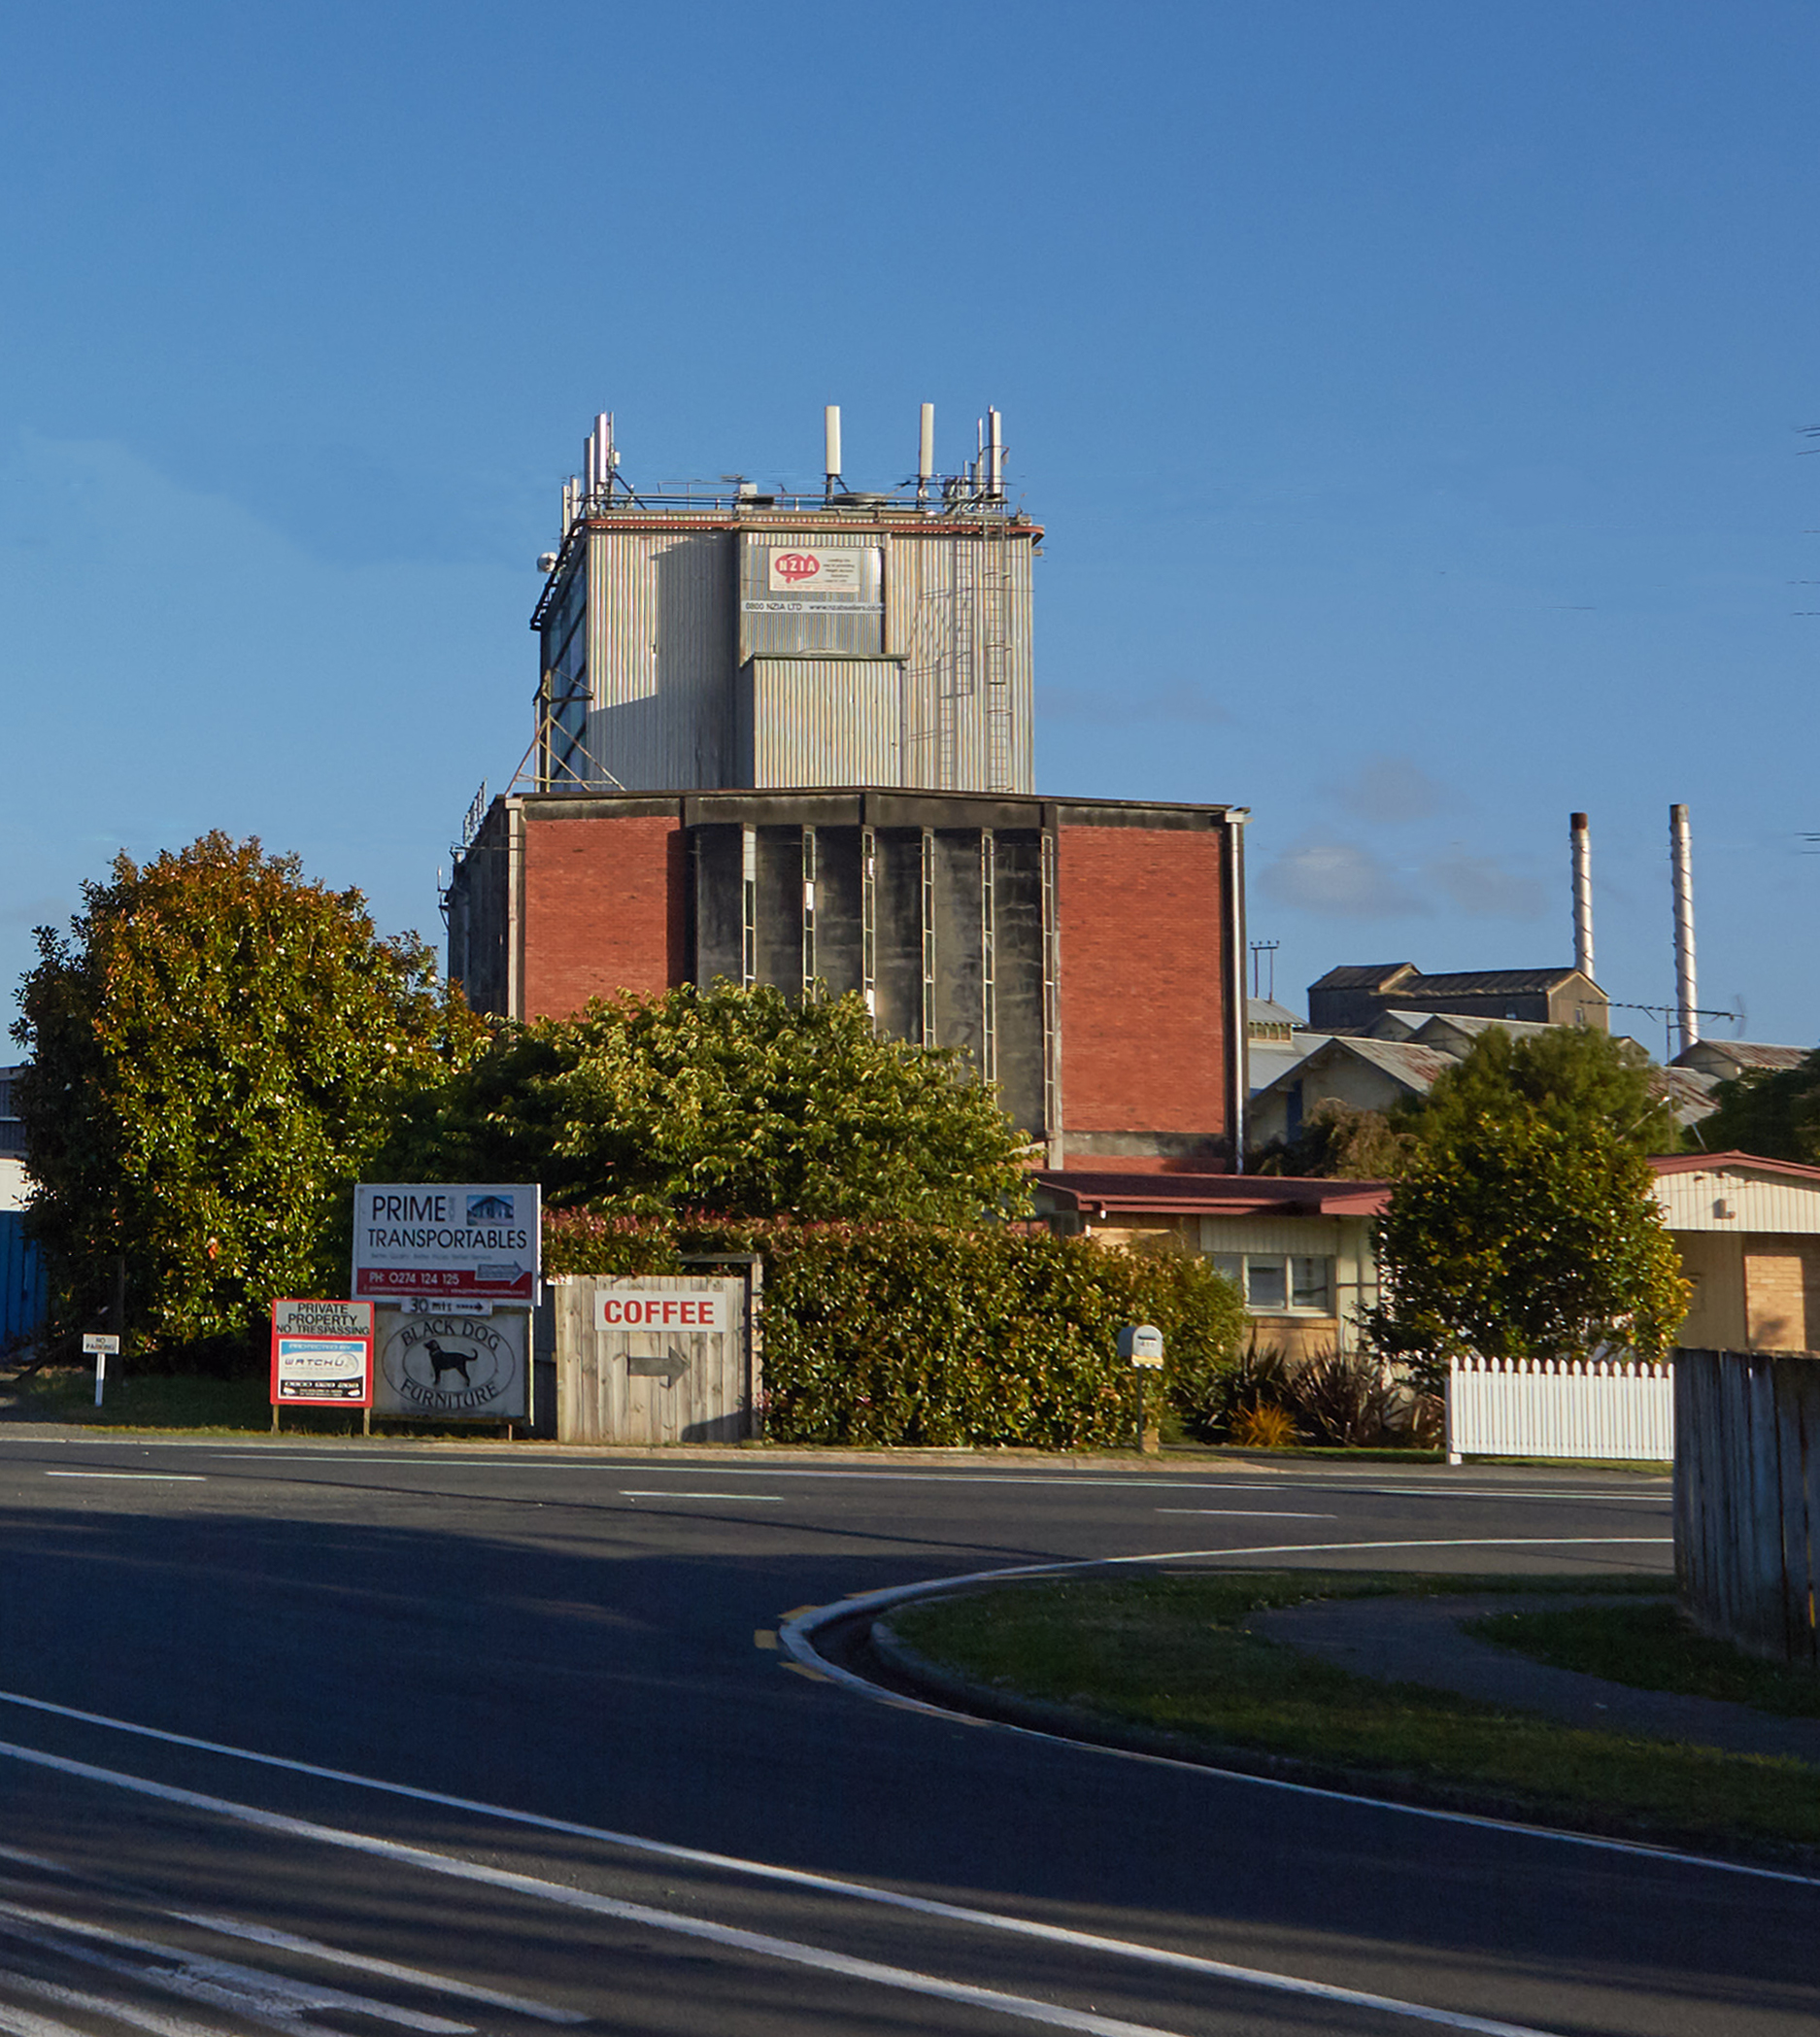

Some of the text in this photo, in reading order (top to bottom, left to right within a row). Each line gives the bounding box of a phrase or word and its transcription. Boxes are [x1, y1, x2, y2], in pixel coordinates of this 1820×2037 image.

[779, 560, 816, 571] NZIA
[745, 602, 764, 611] 0800
[766, 602, 786, 611] NZIA
[372, 1196, 446, 1221] PRIME
[367, 1229, 526, 1248] TRANSPORTABLES
[369, 1273, 459, 1285] PH: 0274 124 125
[298, 1303, 348, 1313] PRIVATE
[410, 1298, 428, 1313] 30
[604, 1300, 715, 1324] COFFEE
[287, 1313, 357, 1326] PROPERTY
[277, 1325, 370, 1336] NO TRESPASSING
[401, 1319, 500, 1351] BLACK DOG
[400, 1377, 499, 1409] FURNITURE
